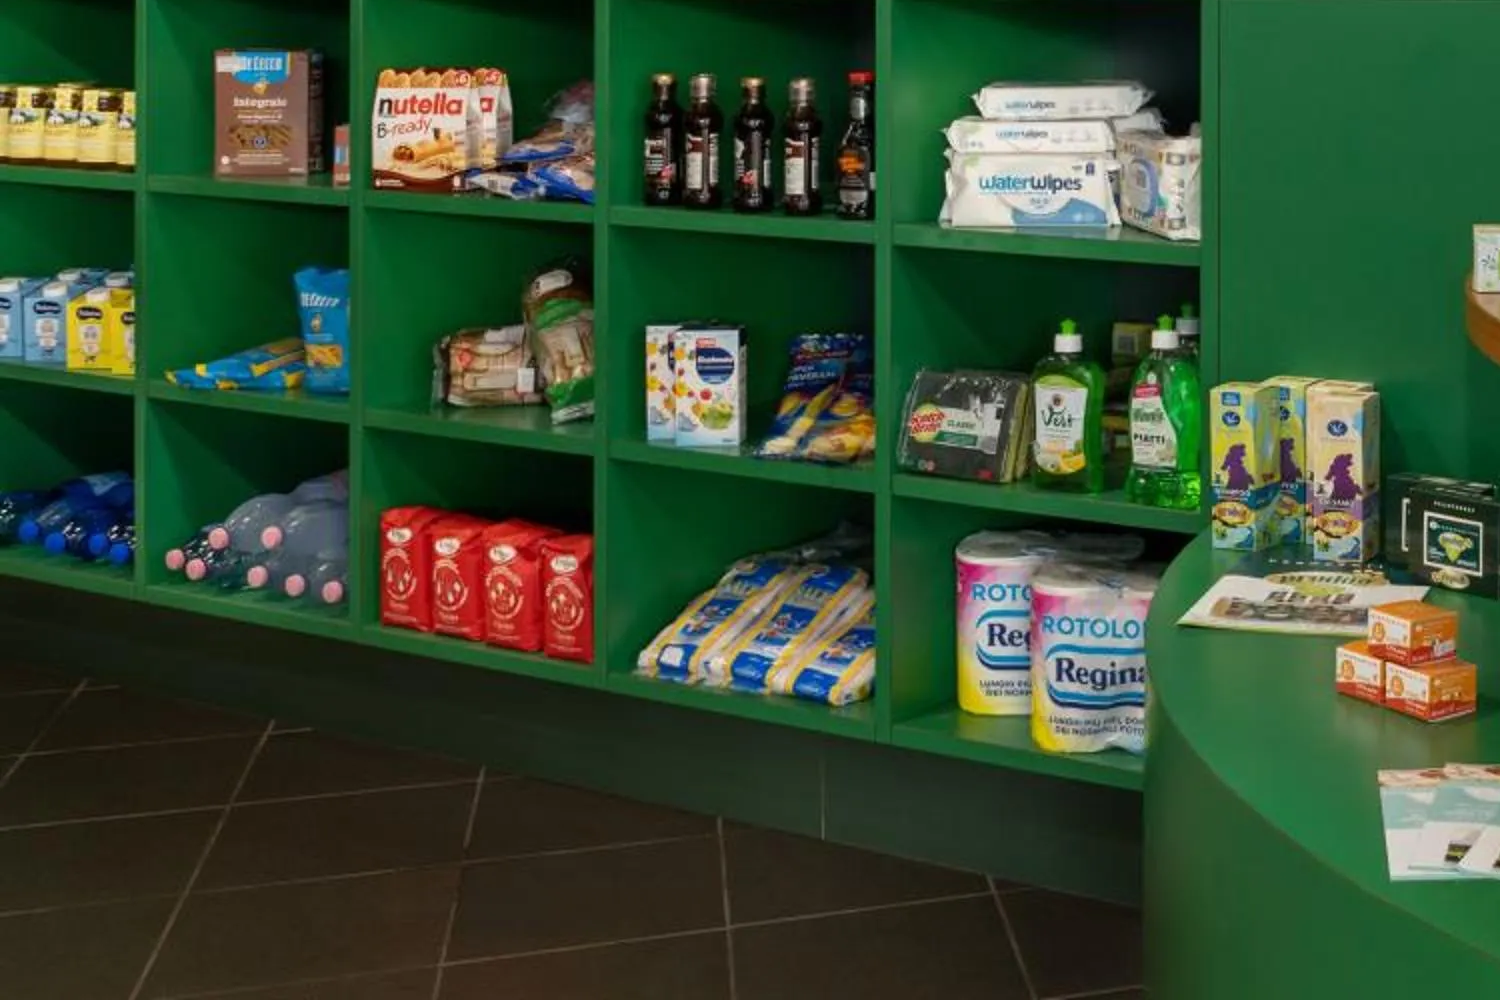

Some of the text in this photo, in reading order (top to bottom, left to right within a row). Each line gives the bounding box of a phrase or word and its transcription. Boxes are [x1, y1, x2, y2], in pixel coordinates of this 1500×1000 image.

[379, 92, 465, 116] nutella
[377, 117, 433, 139] B-ready
[1133, 434, 1165, 444] PIATTI
[1041, 615, 1146, 639] ROTOLO
